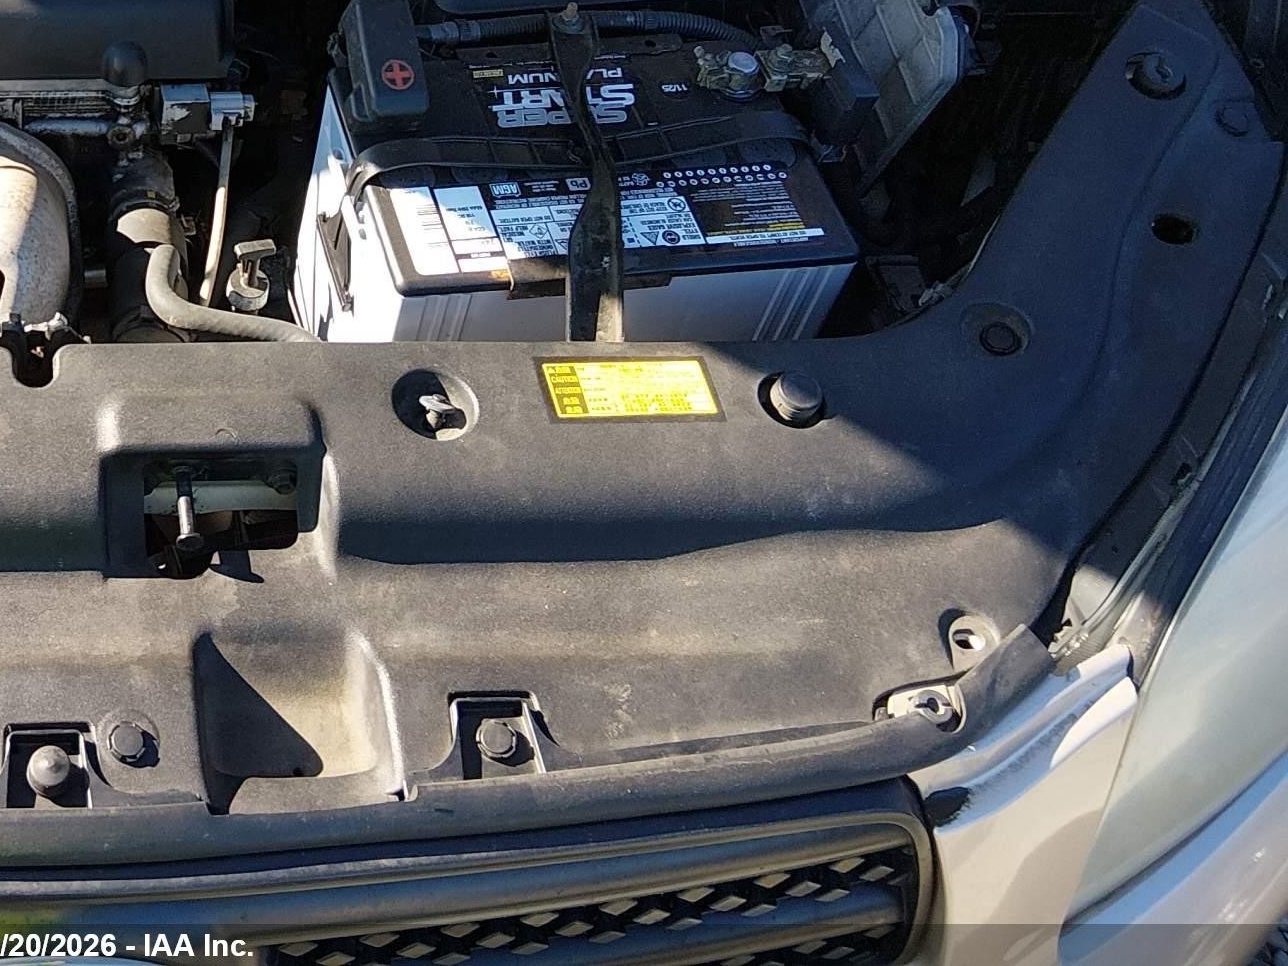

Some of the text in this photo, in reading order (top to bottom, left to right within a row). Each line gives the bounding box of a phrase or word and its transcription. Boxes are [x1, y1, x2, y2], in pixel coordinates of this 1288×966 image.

[507, 67, 622, 85] PLNUM
[661, 83, 688, 93] 11/25
[570, 179, 588, 189] Pb
[492, 184, 517, 195] AGM
